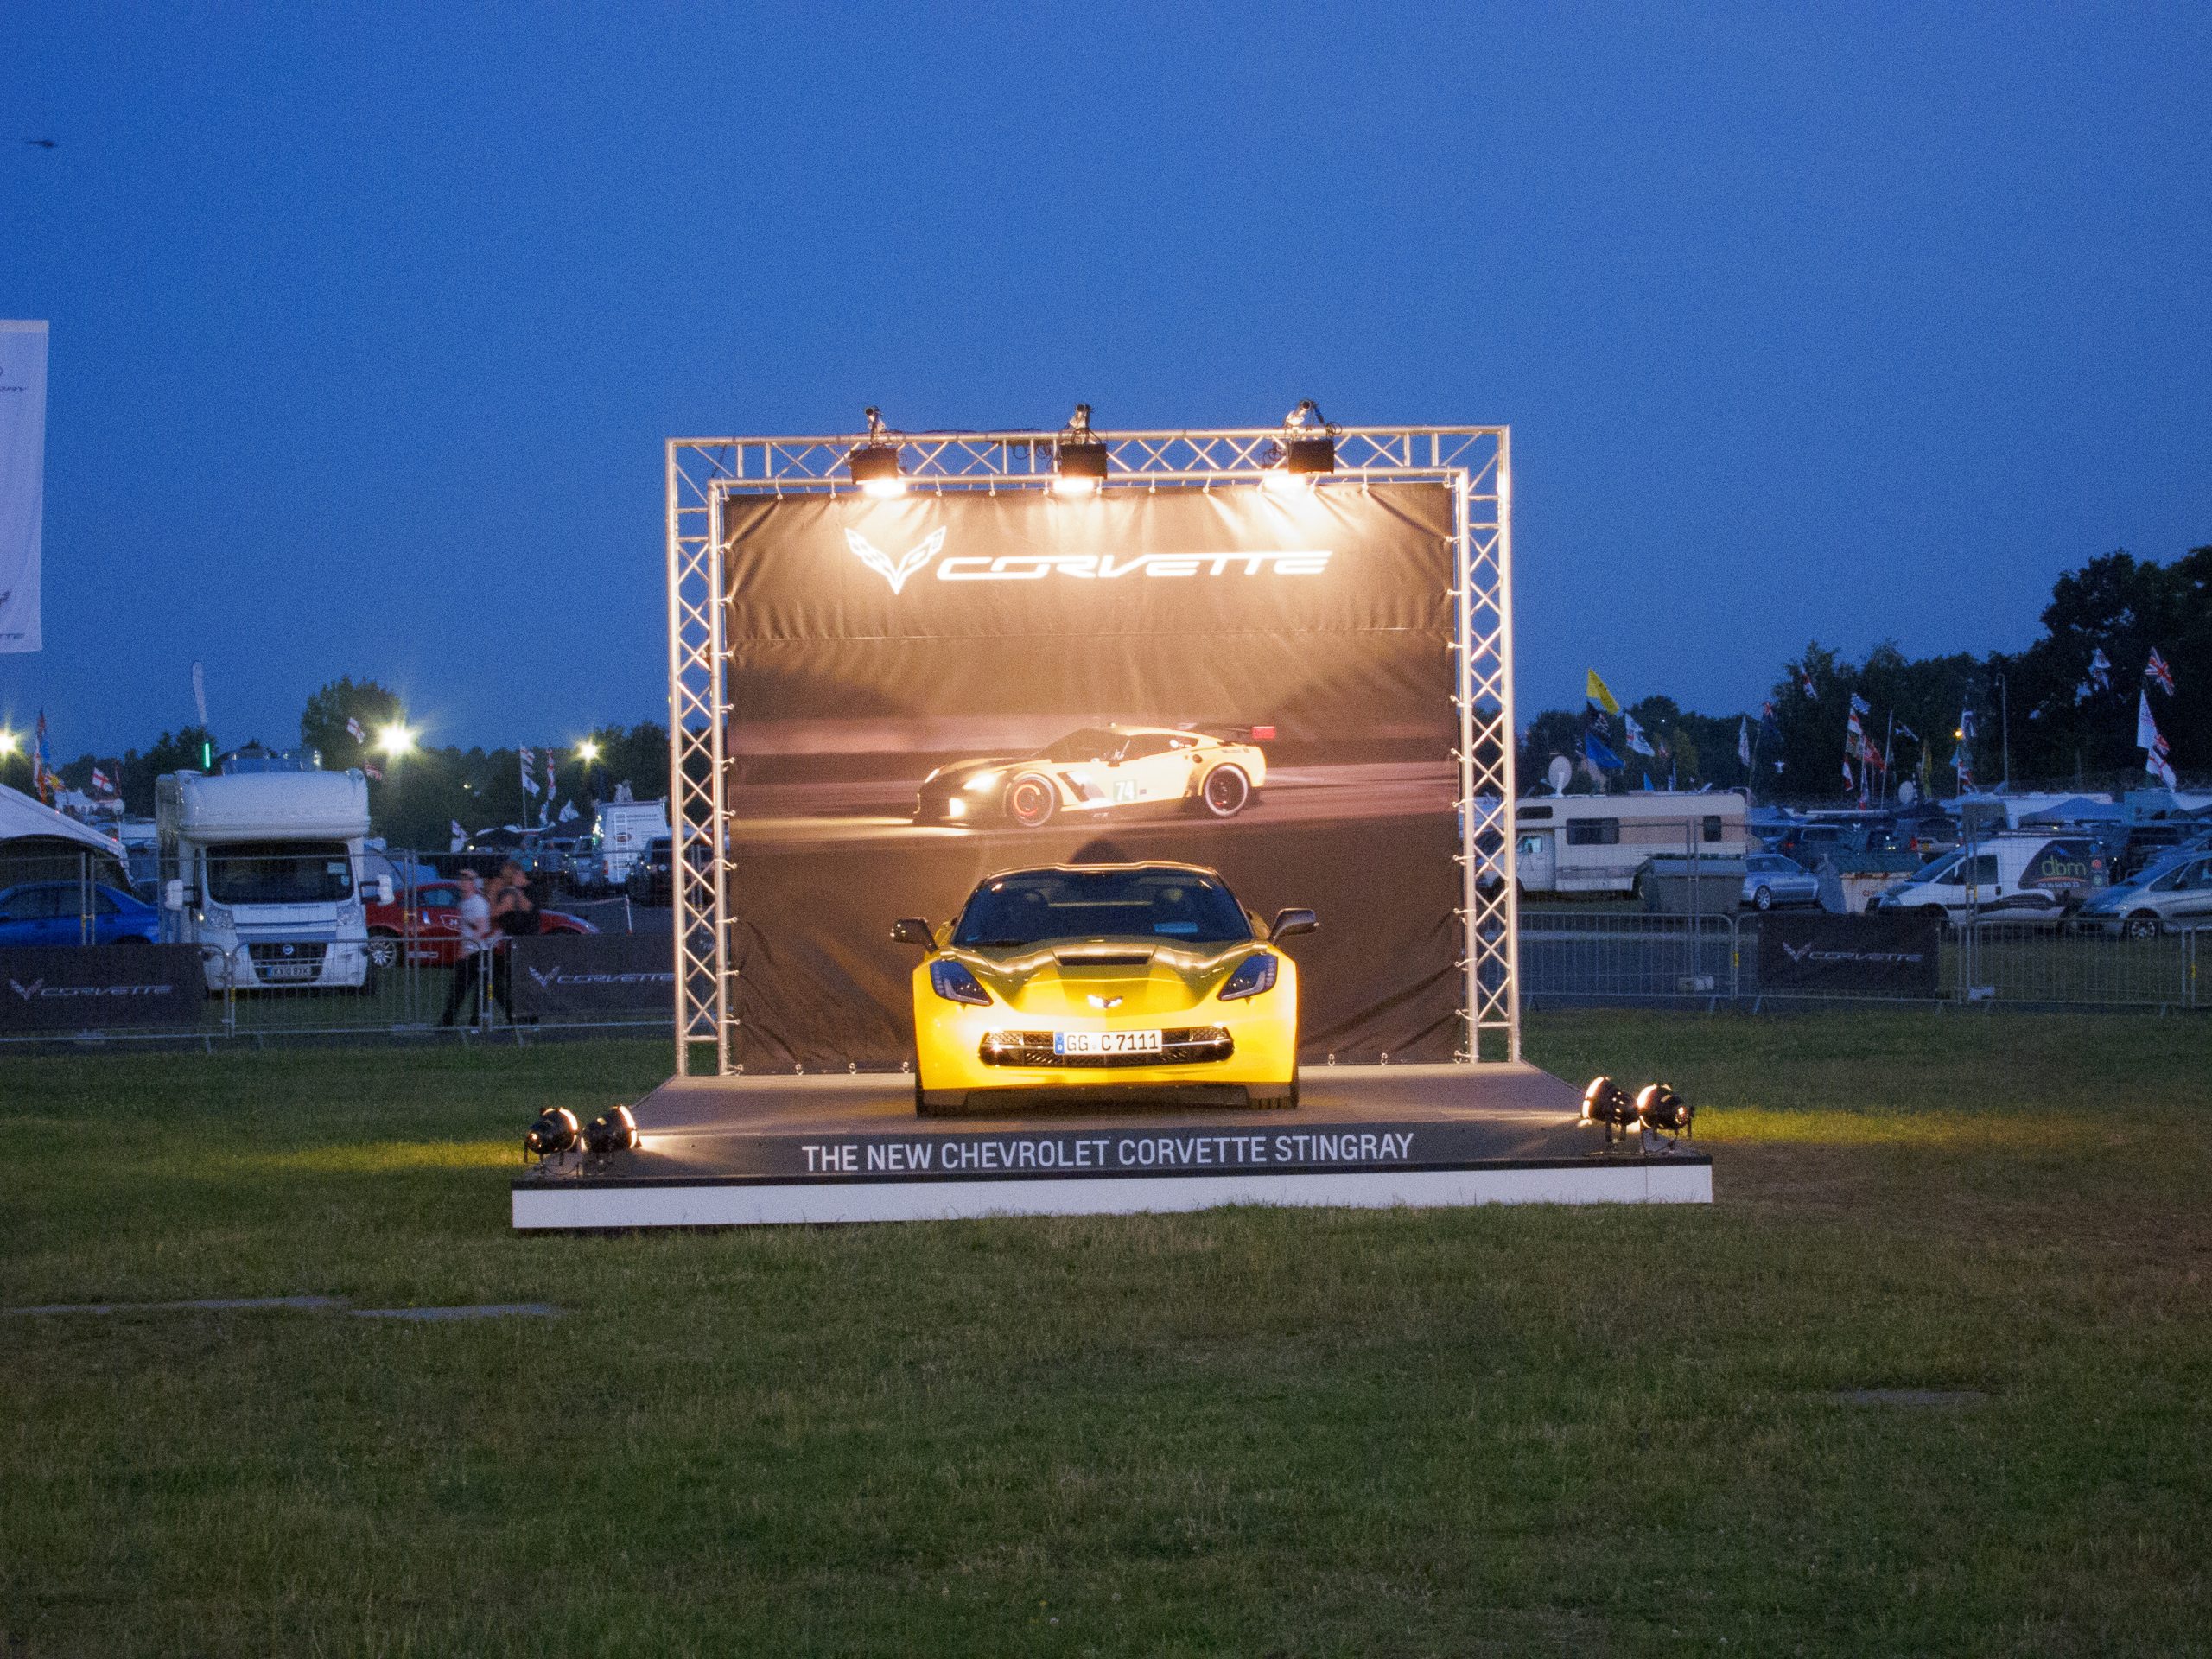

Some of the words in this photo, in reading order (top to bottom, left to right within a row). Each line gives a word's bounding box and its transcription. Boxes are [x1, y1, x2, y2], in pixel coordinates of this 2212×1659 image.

[937, 550, 1333, 581] CORVETTE
[1115, 781, 1135, 803] 74
[2041, 854, 2087, 876] dbm
[1808, 951, 1923, 961] CORVETTE
[557, 973, 675, 984] CORVETTE
[41, 984, 173, 996] CORVETTE
[1066, 1035, 1089, 1051] GG
[801, 1145, 859, 1172] THE
[867, 1143, 932, 1171] NEW
[941, 1139, 1110, 1170] CHEVROLET
[1118, 1135, 1267, 1166] CORVETTE
[1275, 1132, 1414, 1163] STINGRAY
